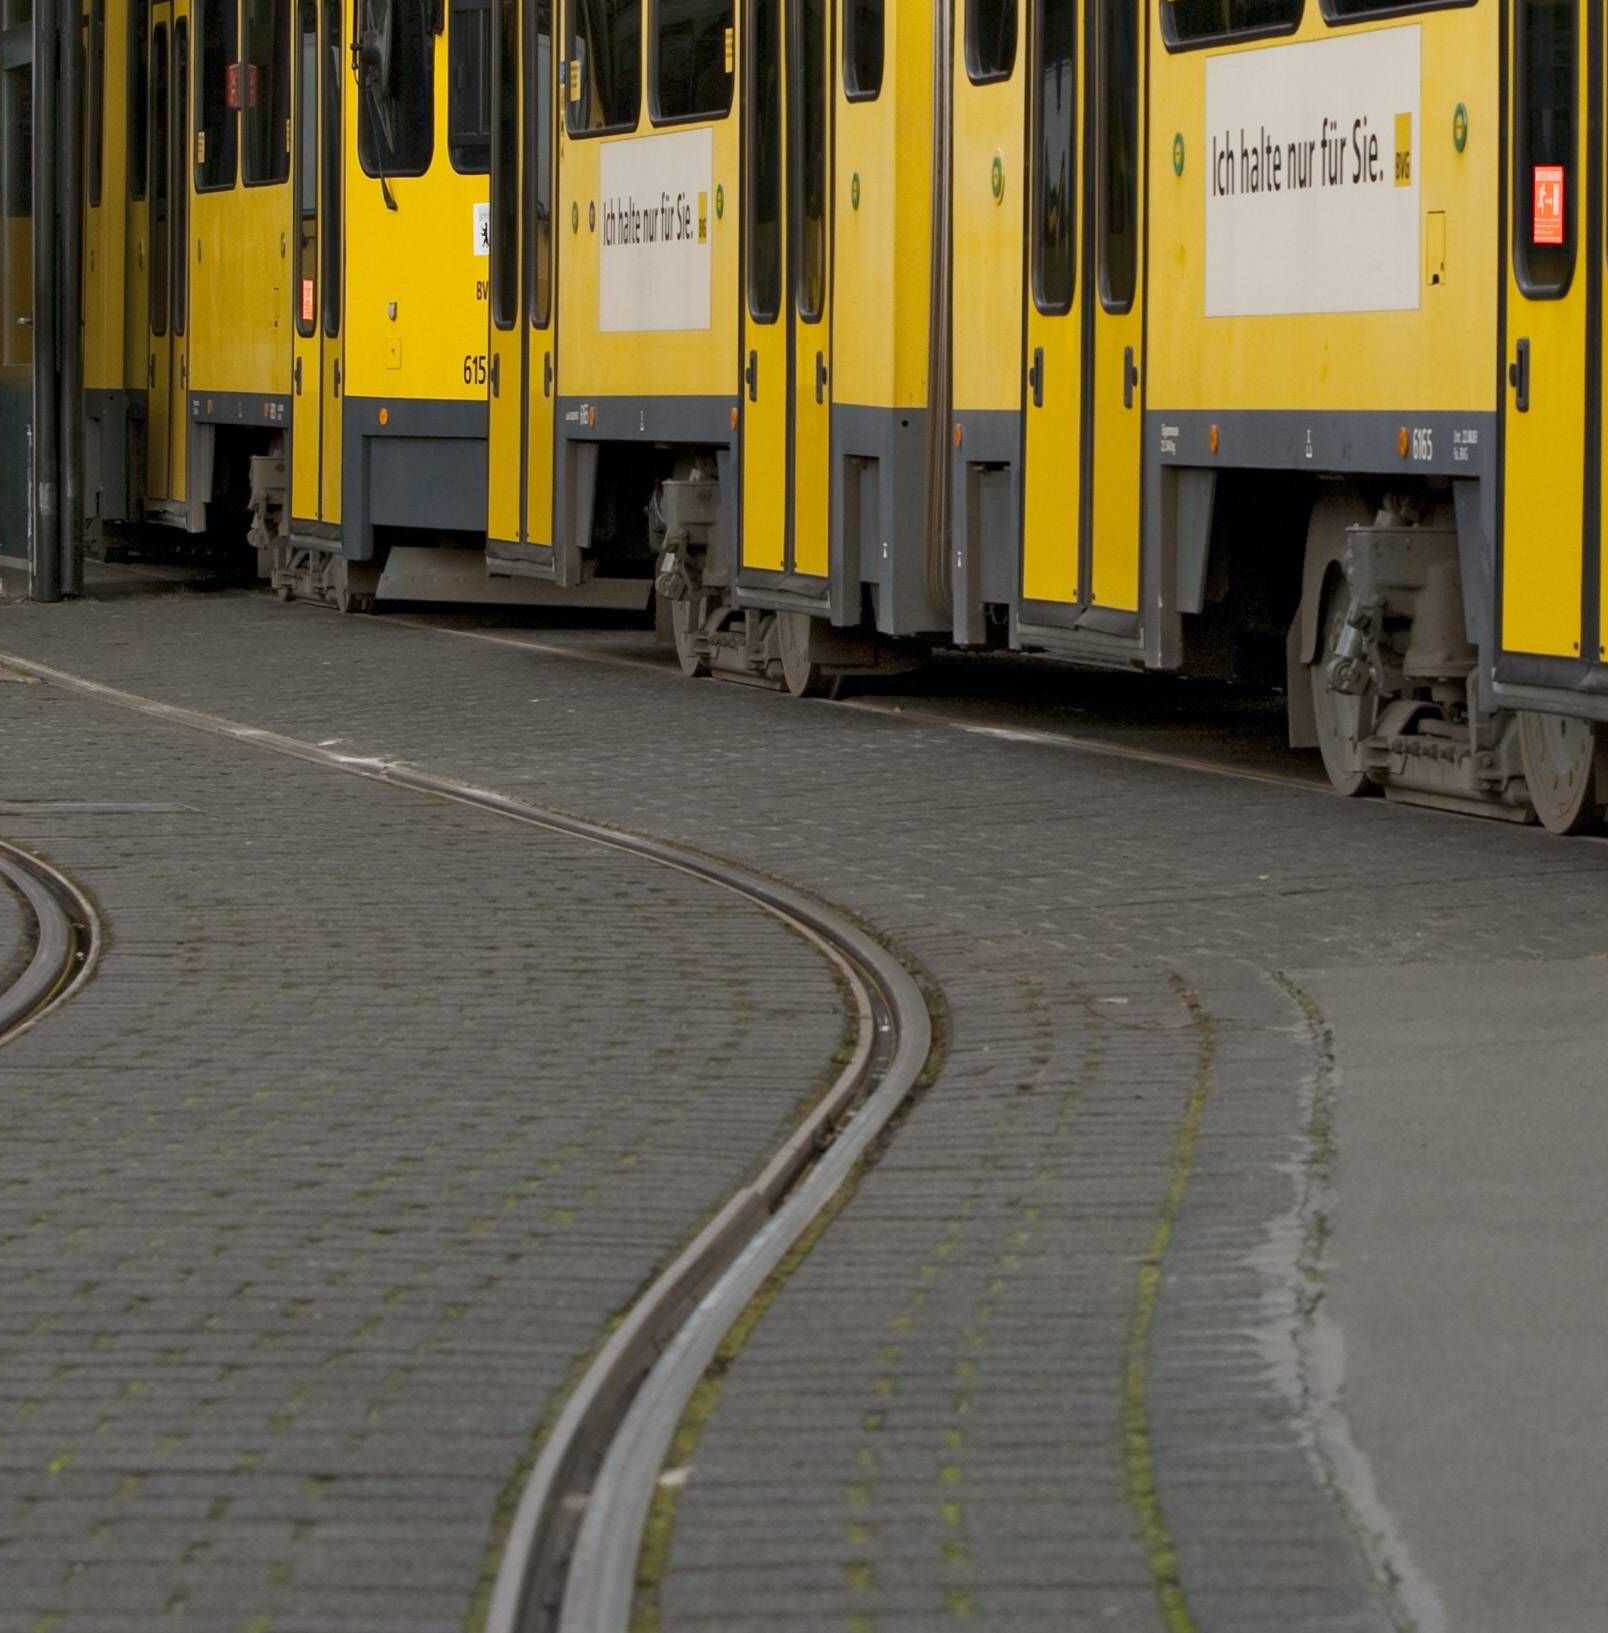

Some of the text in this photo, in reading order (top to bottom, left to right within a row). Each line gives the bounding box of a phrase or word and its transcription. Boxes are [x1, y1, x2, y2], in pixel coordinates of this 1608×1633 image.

[1212, 129, 1236, 197] Ich
[1240, 125, 1282, 194] halte
[1287, 140, 1316, 190] nur
[1321, 116, 1347, 187] für
[1352, 115, 1384, 184] Sie.
[603, 197, 616, 246] Ich
[618, 195, 641, 244] halte
[643, 208, 659, 243] nur
[660, 191, 674, 241] für
[676, 191, 694, 241] Sie.
[476, 280, 489, 301] BV
[463, 354, 487, 385] 615
[1413, 428, 1433, 461] 6165
